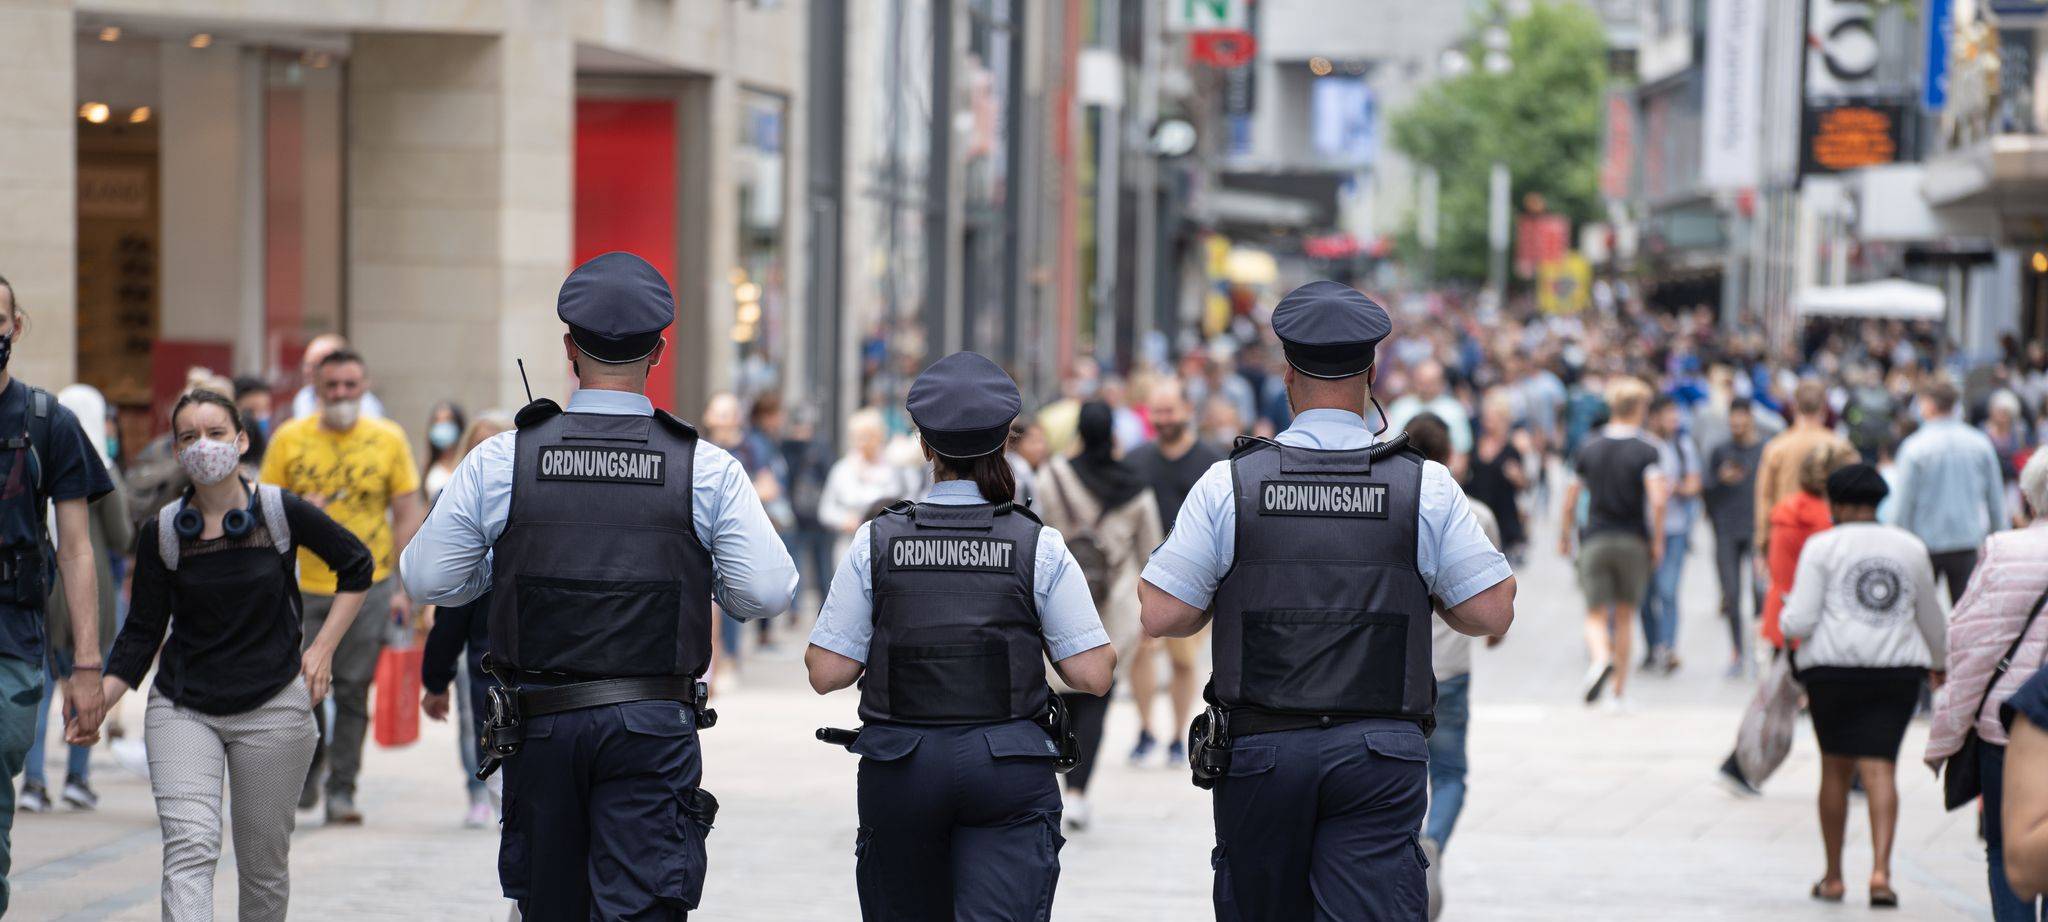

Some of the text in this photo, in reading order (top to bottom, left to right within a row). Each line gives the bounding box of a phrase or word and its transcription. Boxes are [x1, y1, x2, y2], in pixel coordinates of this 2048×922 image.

[542, 450, 662, 479] ORDNUNGSAMT
[1265, 485, 1385, 512] ORDNUNGSAMT
[893, 540, 1012, 567] ORDNUNGSAMT
